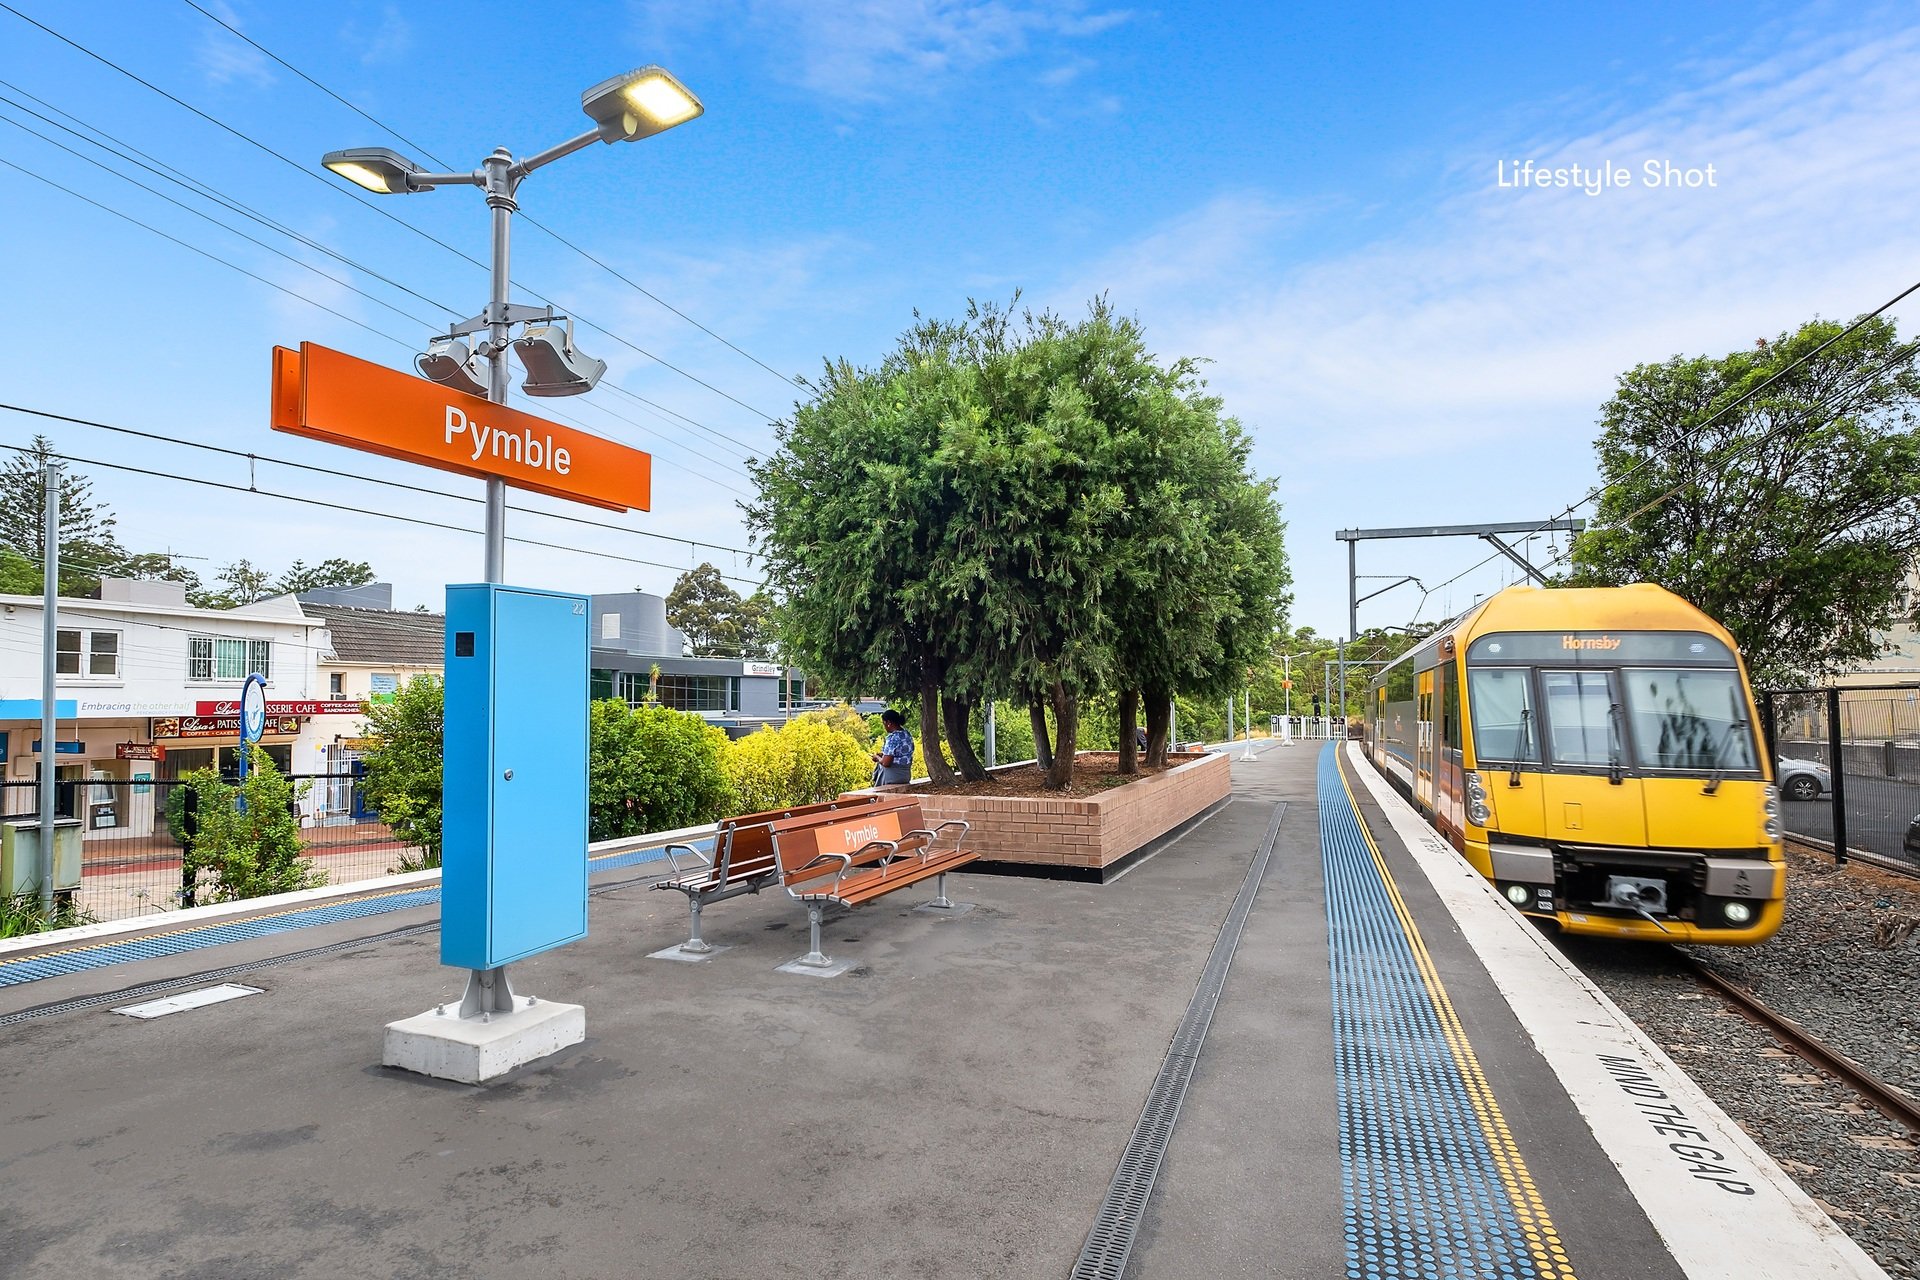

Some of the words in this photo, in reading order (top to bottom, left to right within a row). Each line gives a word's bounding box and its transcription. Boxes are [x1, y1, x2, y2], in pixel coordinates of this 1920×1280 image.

[445, 405, 571, 475] Pymble
[572, 602, 585, 616] 22
[1562, 635, 1620, 650] Hornsby
[752, 664, 776, 675] Grindley
[81, 702, 131, 712] Embracing
[133, 702, 148, 711] the
[149, 702, 173, 711] other
[174, 701, 190, 712] half
[213, 701, 240, 715] Lisa
[265, 704, 293, 713] SSERIE
[296, 704, 317, 713] CAFE
[181, 717, 215, 731] Lisa's
[217, 720, 241, 729] PATISS
[264, 719, 278, 728] AFE
[844, 824, 879, 848] Pymble
[1595, 1053, 1669, 1100] MIND
[1634, 1102, 1710, 1143] THE
[1668, 1143, 1756, 1196] GAP
